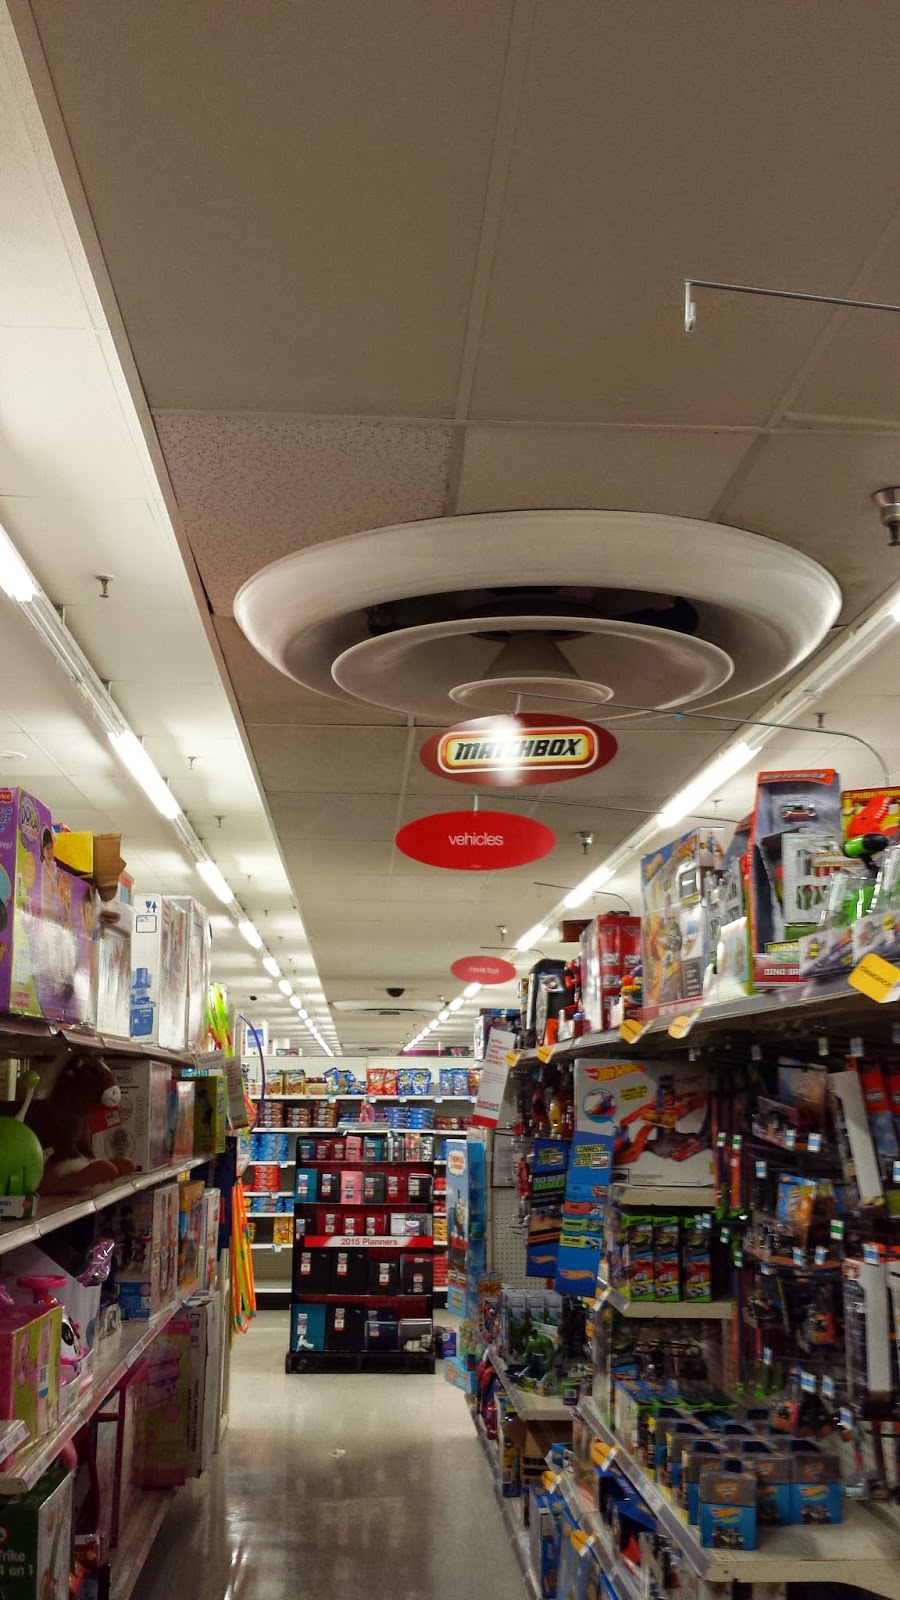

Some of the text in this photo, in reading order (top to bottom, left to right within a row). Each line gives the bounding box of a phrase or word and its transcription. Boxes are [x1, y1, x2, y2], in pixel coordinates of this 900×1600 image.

[449, 832, 504, 846] vehicles
[469, 966, 499, 975] movie toys
[341, 1237, 398, 1246] 2015 Planners
